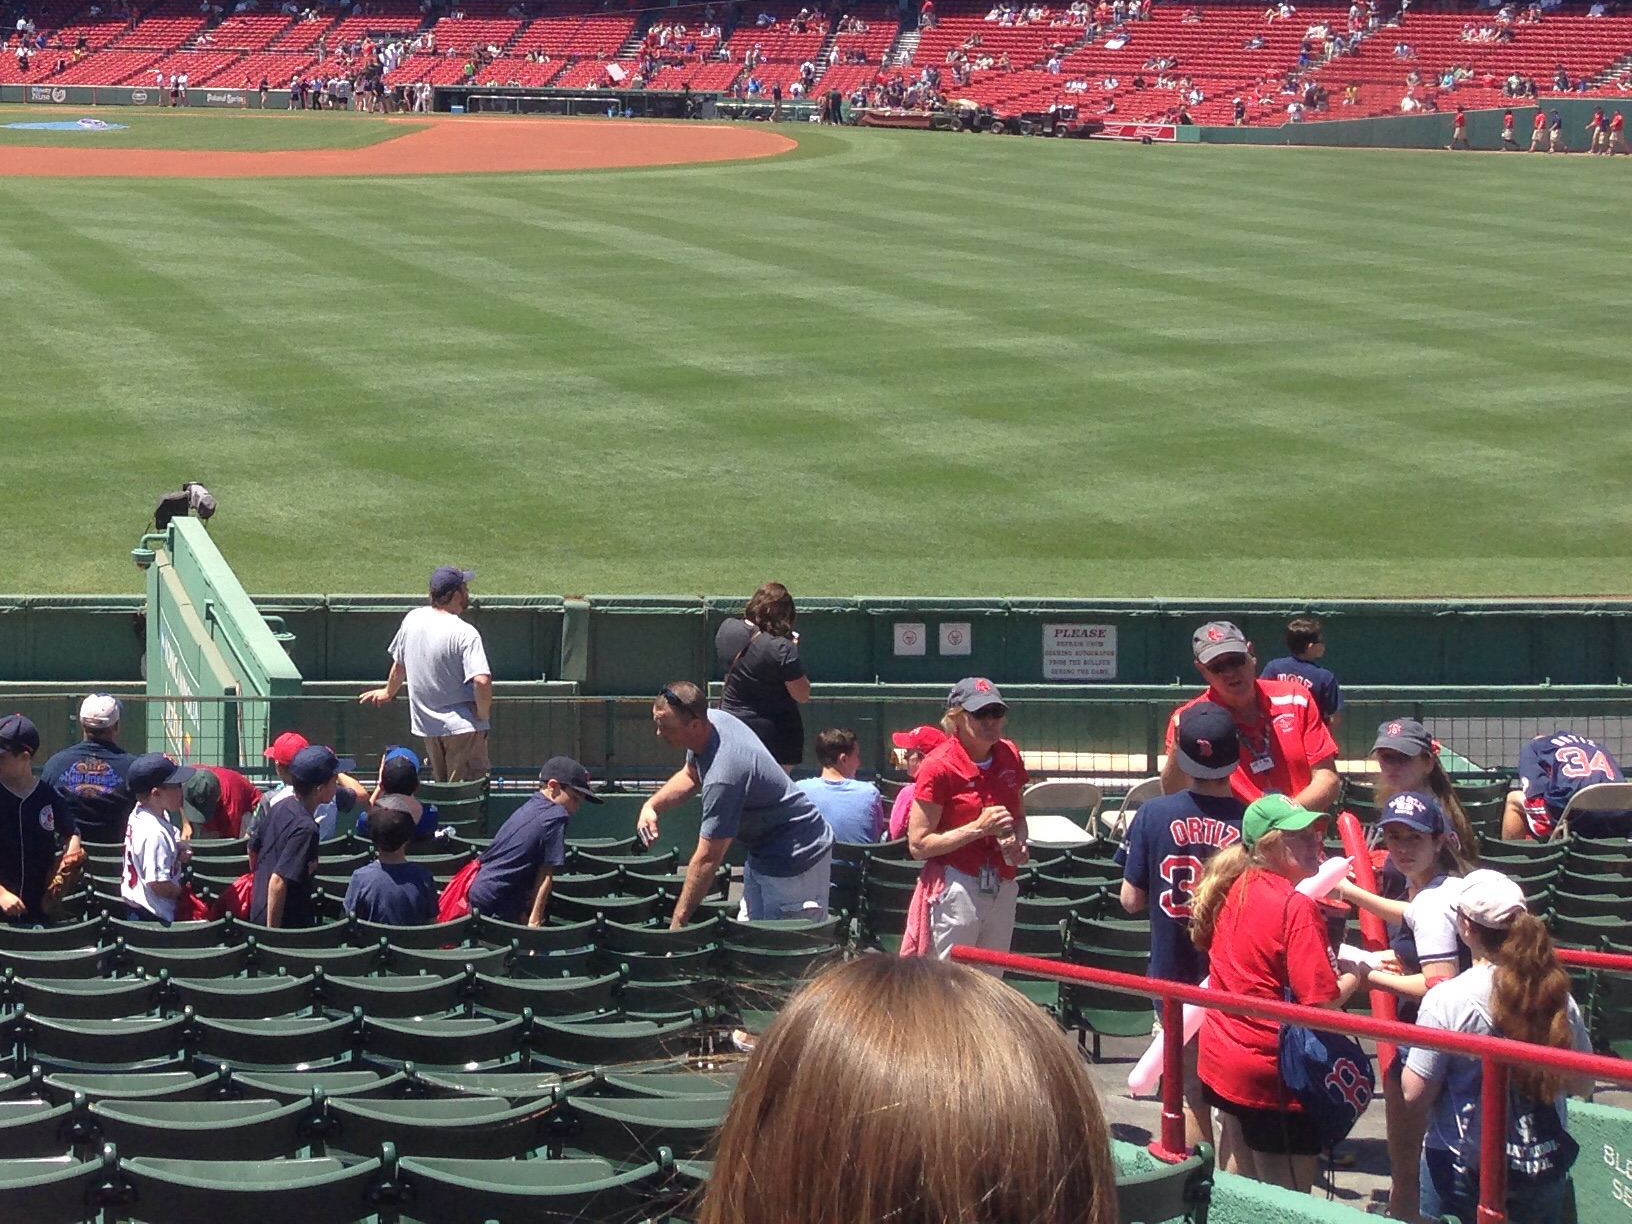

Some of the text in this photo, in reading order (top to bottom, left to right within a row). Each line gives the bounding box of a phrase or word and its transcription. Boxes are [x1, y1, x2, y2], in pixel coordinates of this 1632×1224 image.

[1054, 629, 1107, 638] PLEASE
[1555, 747, 1615, 781] 34
[1170, 817, 1241, 849] ORTIZ
[1325, 1057, 1373, 1119] B
